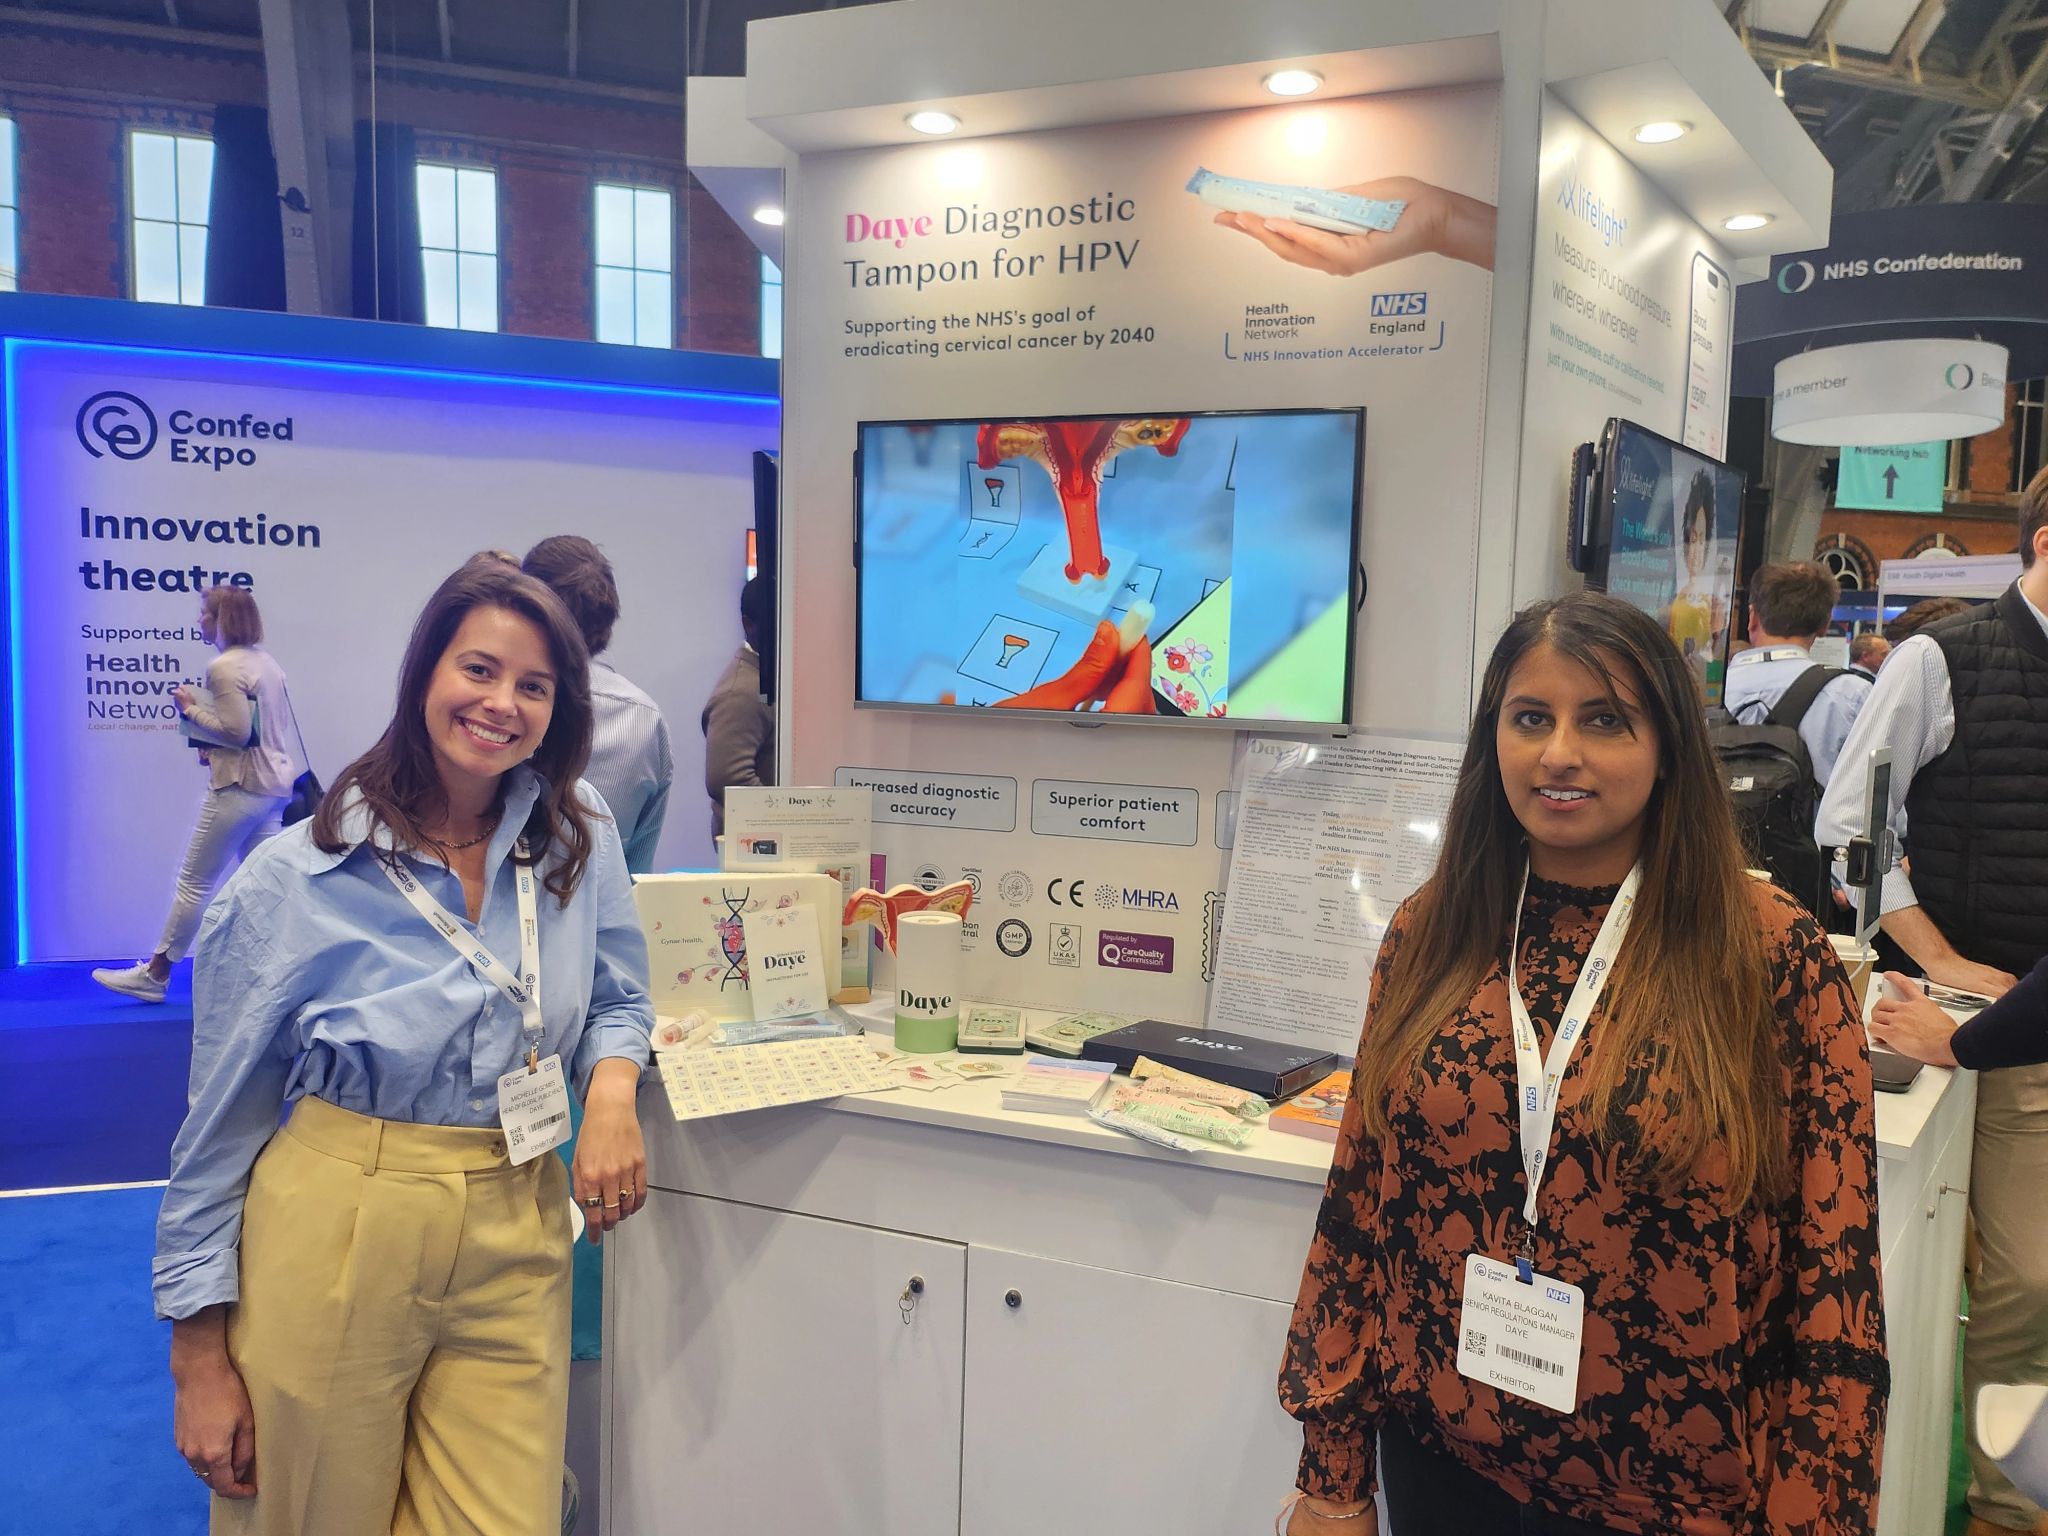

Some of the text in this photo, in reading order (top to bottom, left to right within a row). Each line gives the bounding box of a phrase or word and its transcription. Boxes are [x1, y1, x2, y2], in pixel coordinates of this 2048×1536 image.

[846, 192, 1135, 249] Daye Diagnostic
[291, 227, 304, 238] 12
[844, 239, 1140, 291] Tampon for HPV
[1554, 231, 1597, 279] Measure
[1597, 264, 1617, 290] your
[1617, 271, 1640, 307] blood
[1823, 252, 2023, 280] NHS Confederation
[1245, 294, 1426, 317] Health NHS
[1552, 279, 1598, 323] wherever,
[845, 305, 1096, 337] Supporting the NHS's goal of
[1245, 315, 1426, 337] Innovation England
[844, 326, 1155, 358] eradicating cervical cancer by 2040
[1244, 328, 1299, 340] Network
[1243, 345, 1425, 362] NHS Innovation Accelerator
[1792, 376, 1848, 395] member
[169, 410, 293, 441] Confed
[171, 438, 257, 471] Expo
[80, 507, 321, 548] Innovation
[79, 560, 254, 593] theatre
[81, 624, 184, 643] Supported
[86, 653, 180, 673] Health
[87, 677, 202, 696] Innovai
[88, 700, 178, 719] Netwo
[88, 723, 159, 732] Local change,
[1403, 753, 1436, 761] Diagnostic
[923, 782, 1000, 800] diagnostic
[788, 797, 813, 807] Daye
[890, 803, 956, 820] accuracy
[1050, 791, 1180, 813] Superior patient
[1080, 816, 1146, 831] comfort
[1048, 878, 1179, 910] CE MHRA
[962, 921, 979, 930] bon
[661, 936, 704, 945] Gynae health,
[1005, 931, 1024, 940] GMP
[1102, 933, 1138, 944] Regulated by
[764, 954, 806, 970] Daye
[1053, 951, 1076, 959] UKAS
[1121, 955, 1164, 966] Commission
[900, 989, 951, 1015] Daye
[1562, 1018, 1578, 1041] NHS
[1175, 1036, 1244, 1051] Daye
[511, 1087, 538, 1102] MICHELLE
[1526, 1086, 1537, 1111] NHS
[529, 1103, 544, 1114] DAYE
[530, 1135, 556, 1152] EXHIBITOR
[1488, 1268, 1508, 1279] Confed
[1487, 1274, 1571, 1304] Expo NHS
[1482, 1291, 1558, 1322] KAVITA BLAGGAN
[1465, 1297, 1576, 1341] SENIOR REGULATIONS MANAGER
[1505, 1324, 1529, 1339] DAYE
[1489, 1370, 1536, 1393] EXHIBITOR
